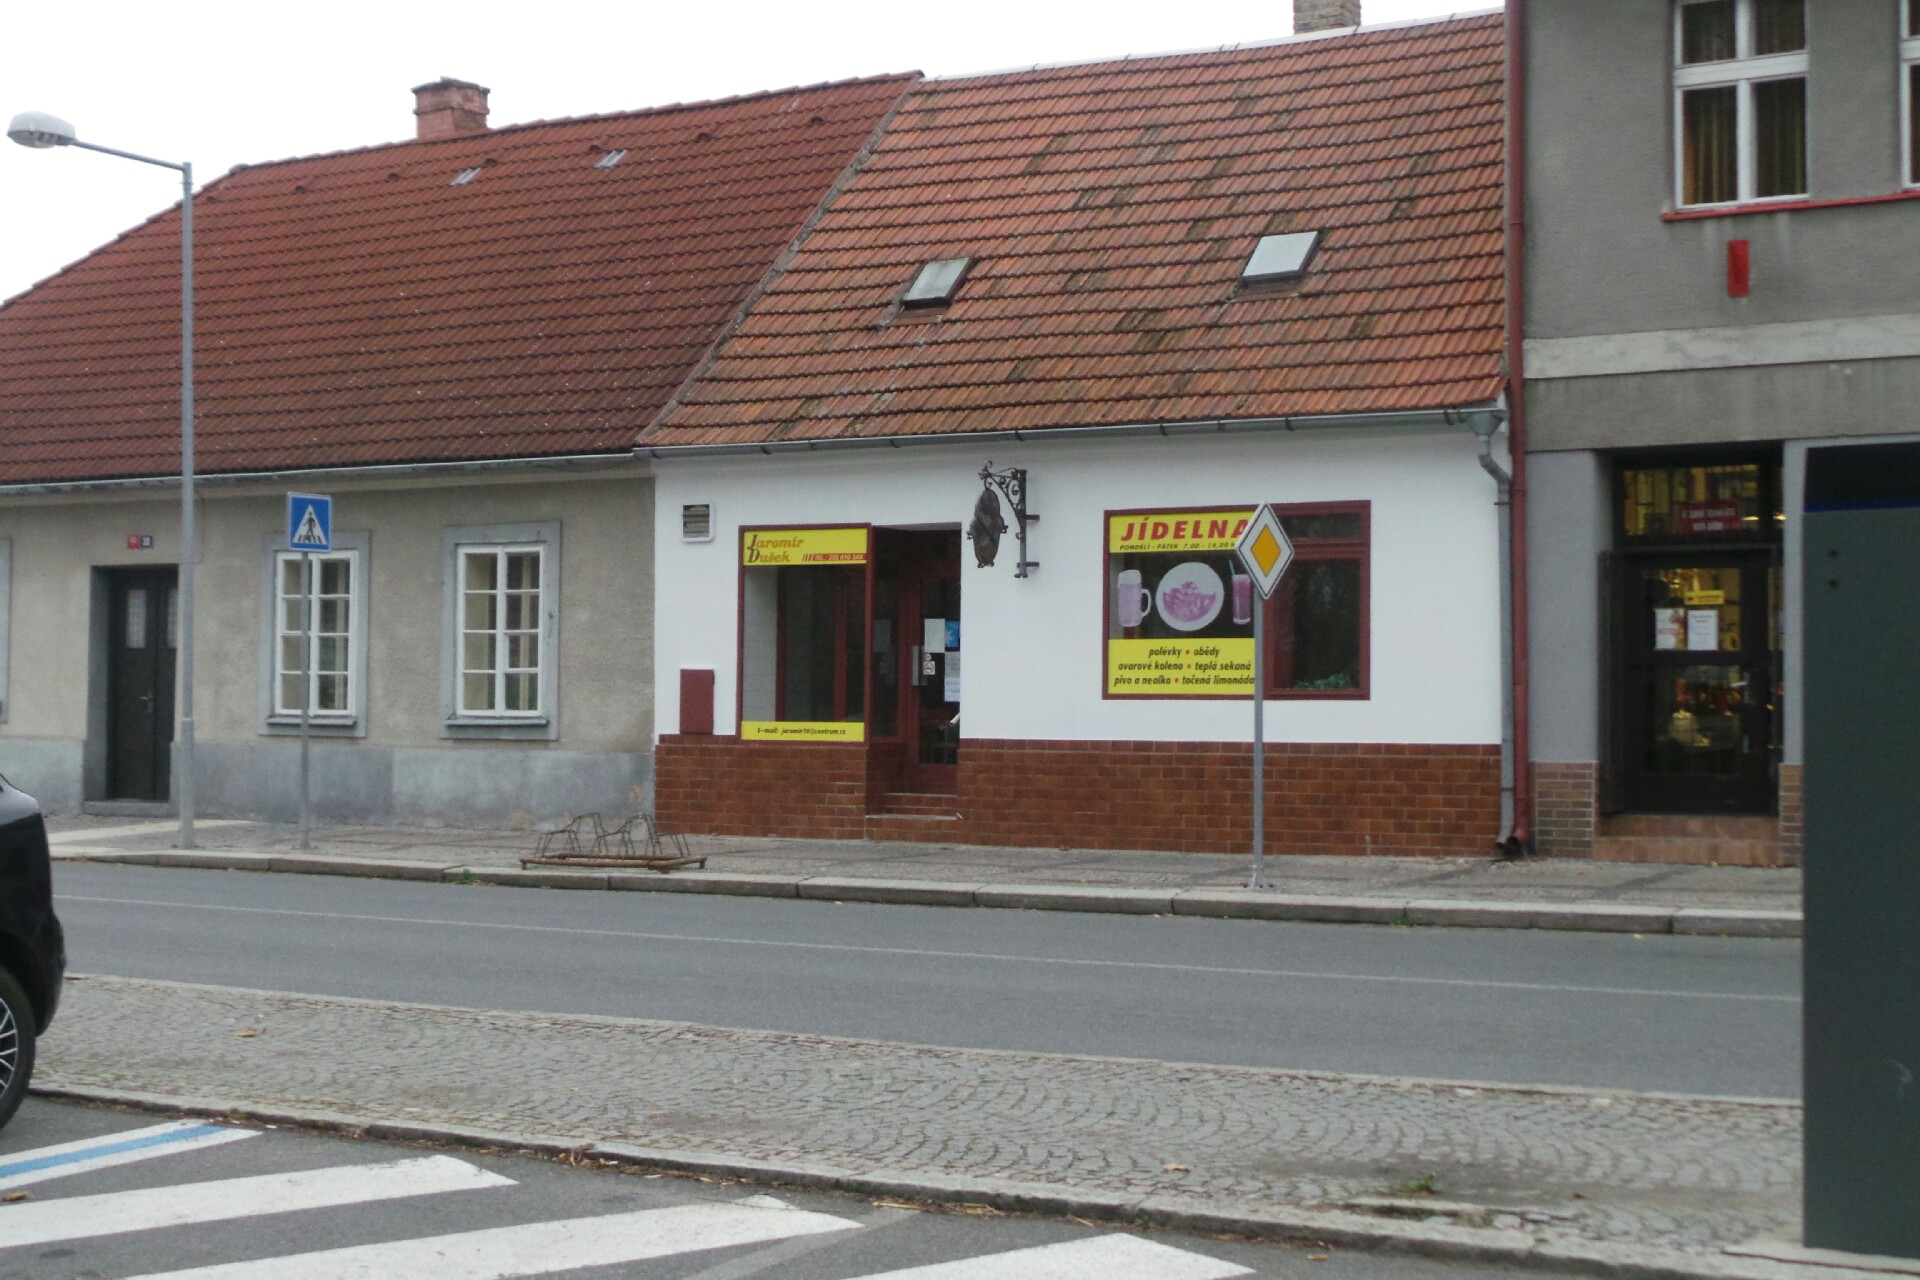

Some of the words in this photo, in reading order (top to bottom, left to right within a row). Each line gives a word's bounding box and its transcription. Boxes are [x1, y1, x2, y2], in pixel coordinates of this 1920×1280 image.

[1121, 516, 1249, 541] JÍDELNA
[747, 534, 804, 550] Jaromír
[747, 548, 790, 563] Dušek
[1148, 646, 1182, 658] polévky
[1193, 646, 1220, 658] obědy
[1118, 661, 1152, 671] ovarové
[1154, 660, 1184, 671] koleno
[1195, 661, 1217, 673] teplá
[1219, 660, 1251, 671] sekaná
[1114, 675, 1132, 687] pivo
[1142, 675, 1171, 685] nealko
[1182, 675, 1211, 685] točená
[1213, 674, 1255, 685] limonáda
